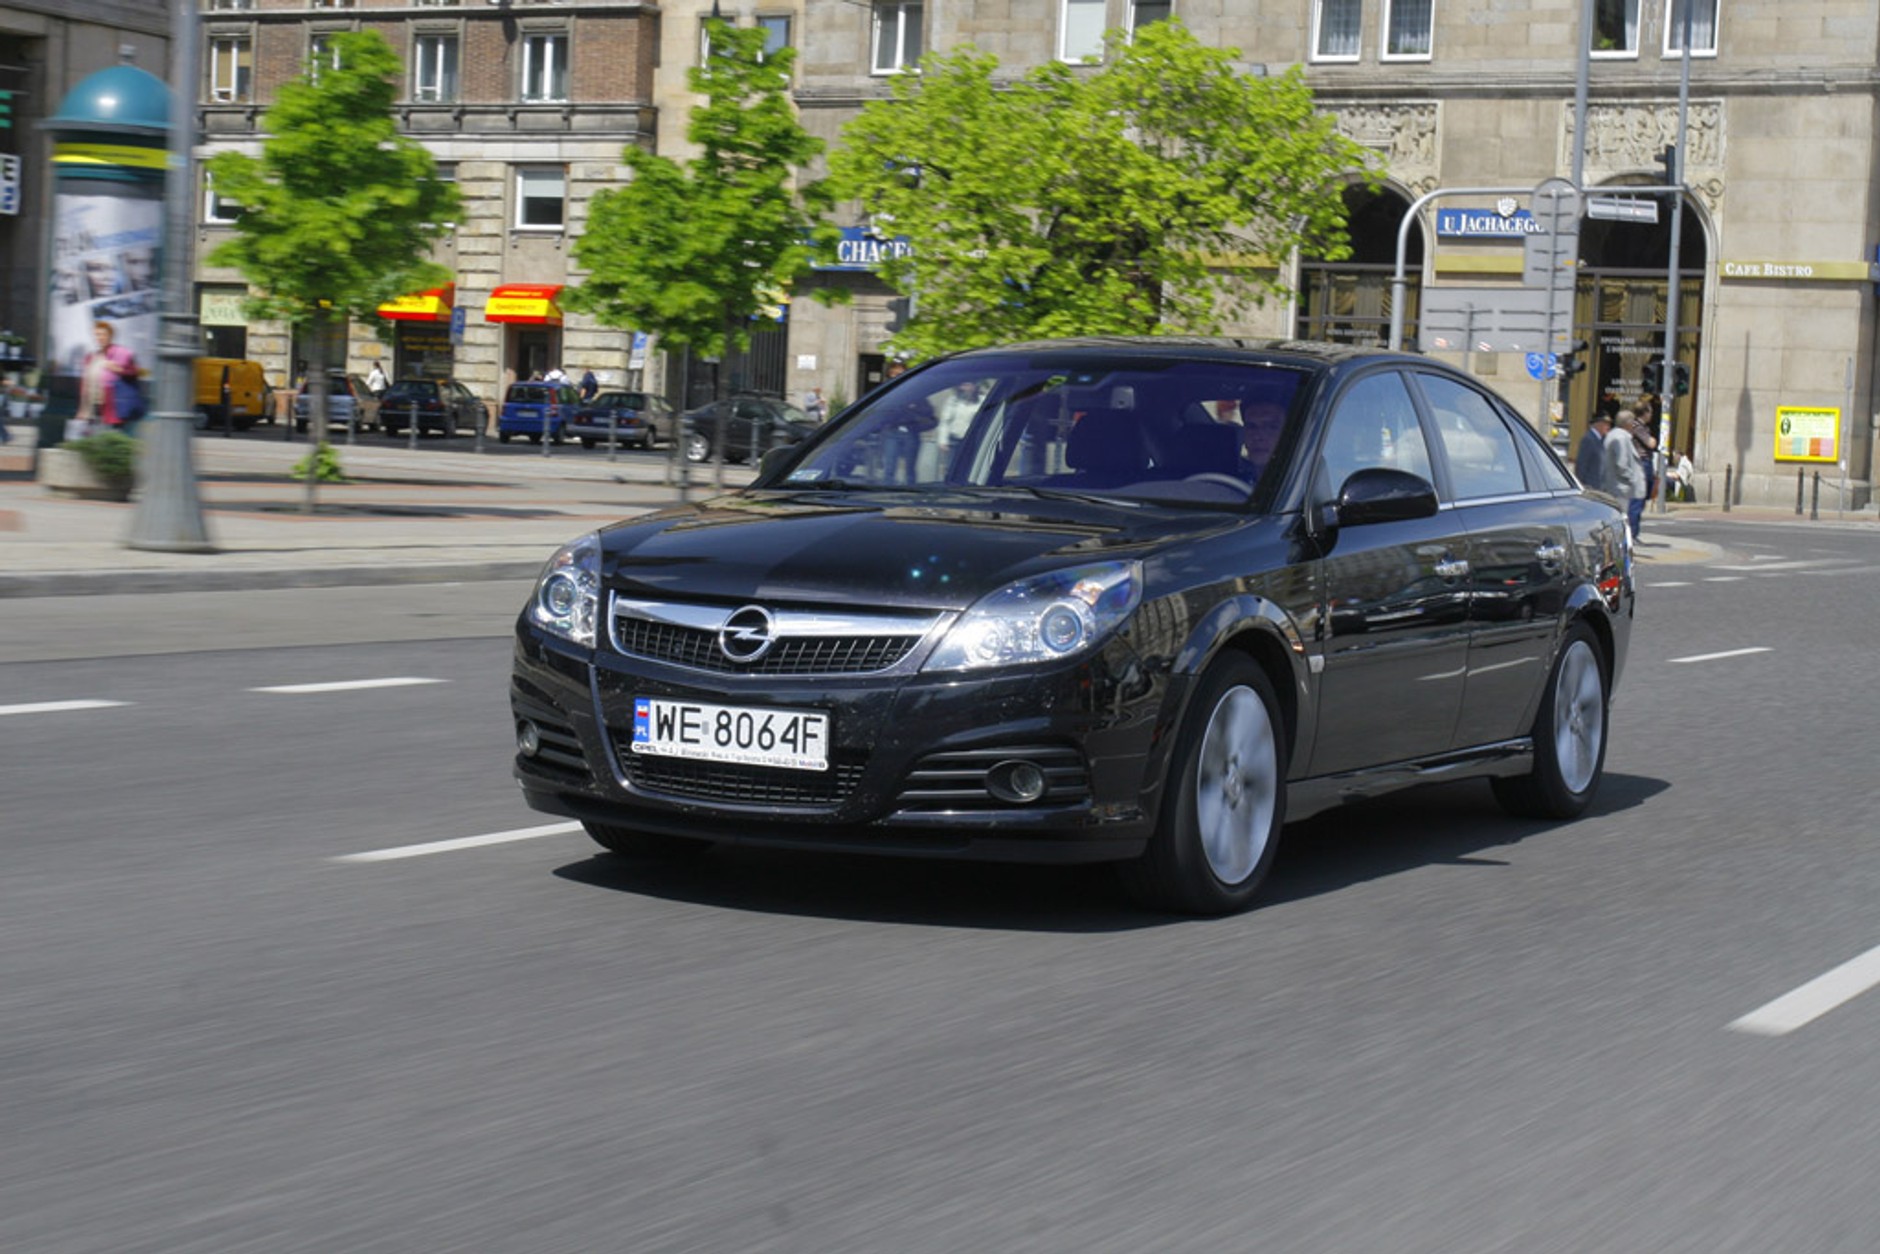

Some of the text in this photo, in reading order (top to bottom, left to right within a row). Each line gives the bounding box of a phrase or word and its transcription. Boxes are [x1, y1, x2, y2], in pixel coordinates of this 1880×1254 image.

[1444, 216, 1455, 231] U
[1724, 262, 1814, 277] CAFE BISTRO
[655, 704, 822, 754] WE 8064F
